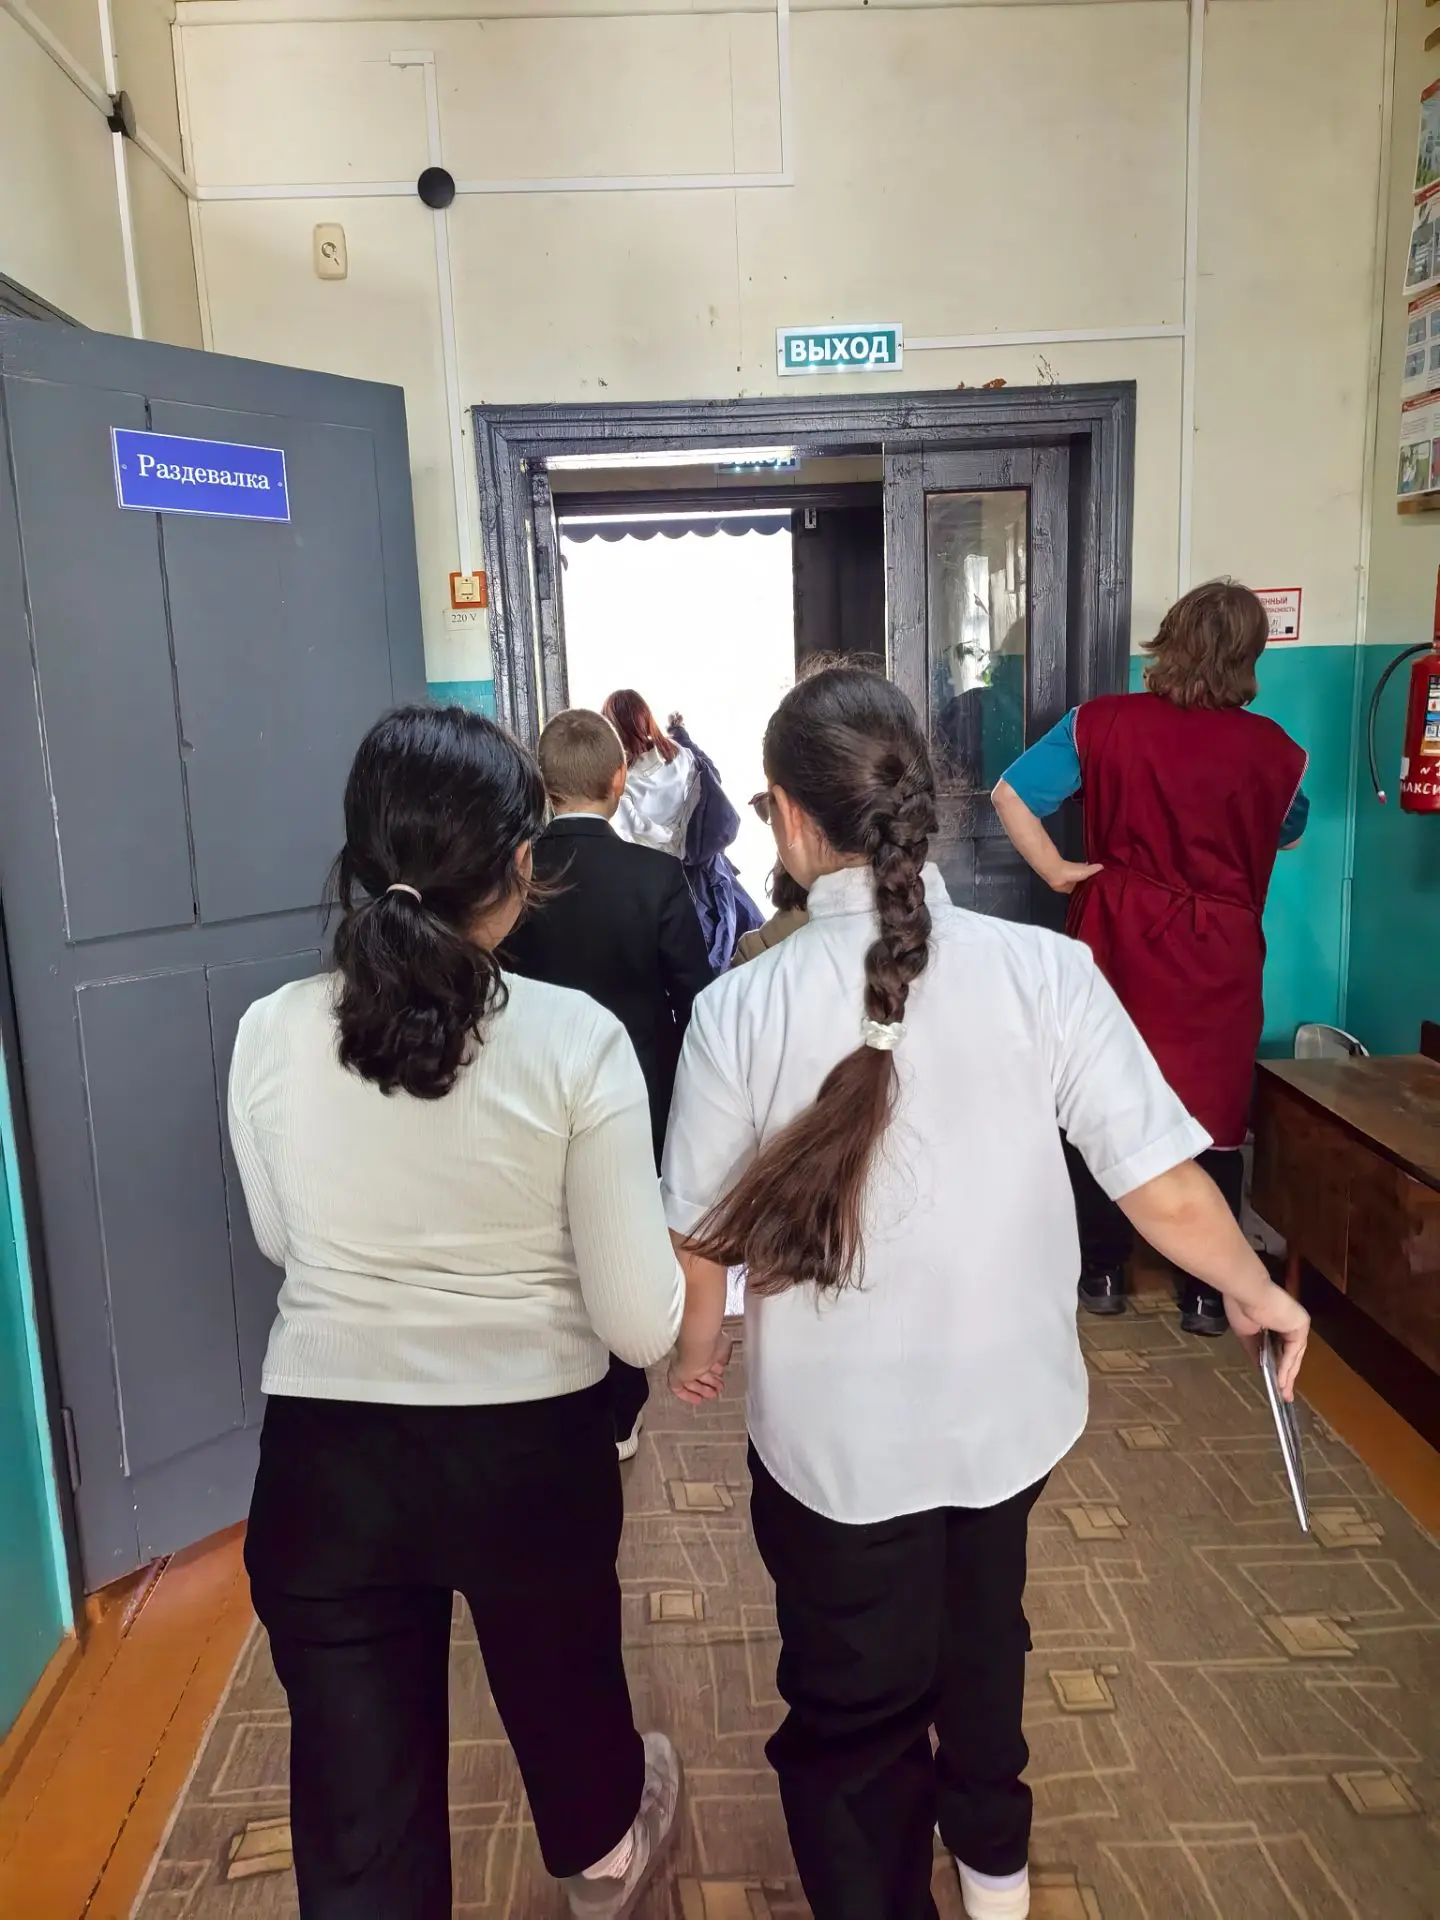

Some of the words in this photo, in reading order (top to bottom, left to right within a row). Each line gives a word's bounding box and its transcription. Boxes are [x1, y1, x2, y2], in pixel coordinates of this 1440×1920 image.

[791, 337, 889, 363] ВЫХОД
[137, 454, 270, 490] Раздевалка
[451, 614, 468, 623] 220
